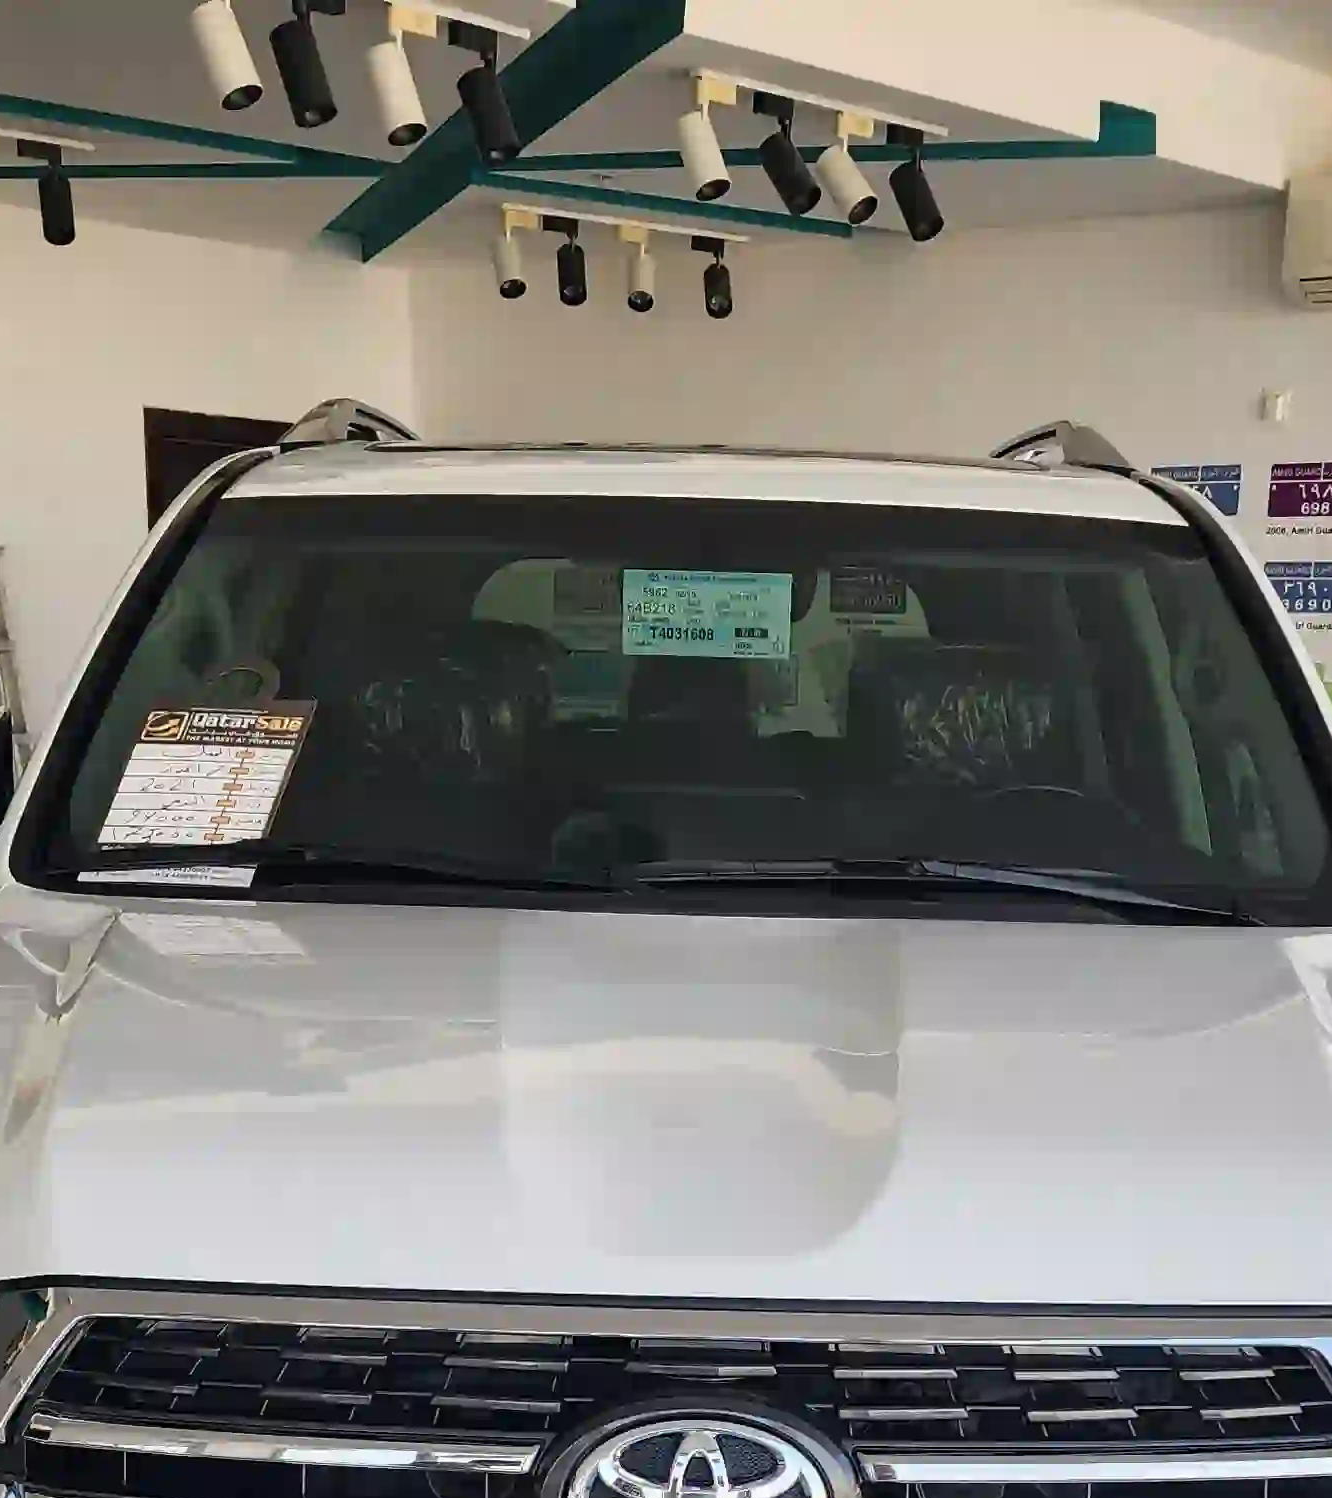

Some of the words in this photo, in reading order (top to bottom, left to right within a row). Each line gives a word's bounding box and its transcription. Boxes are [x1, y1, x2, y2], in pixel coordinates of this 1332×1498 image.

[1301, 502, 1330, 515] 698
[1283, 581, 1329, 597] ٣٦٩٠
[193, 712, 304, 731] QatarSale
